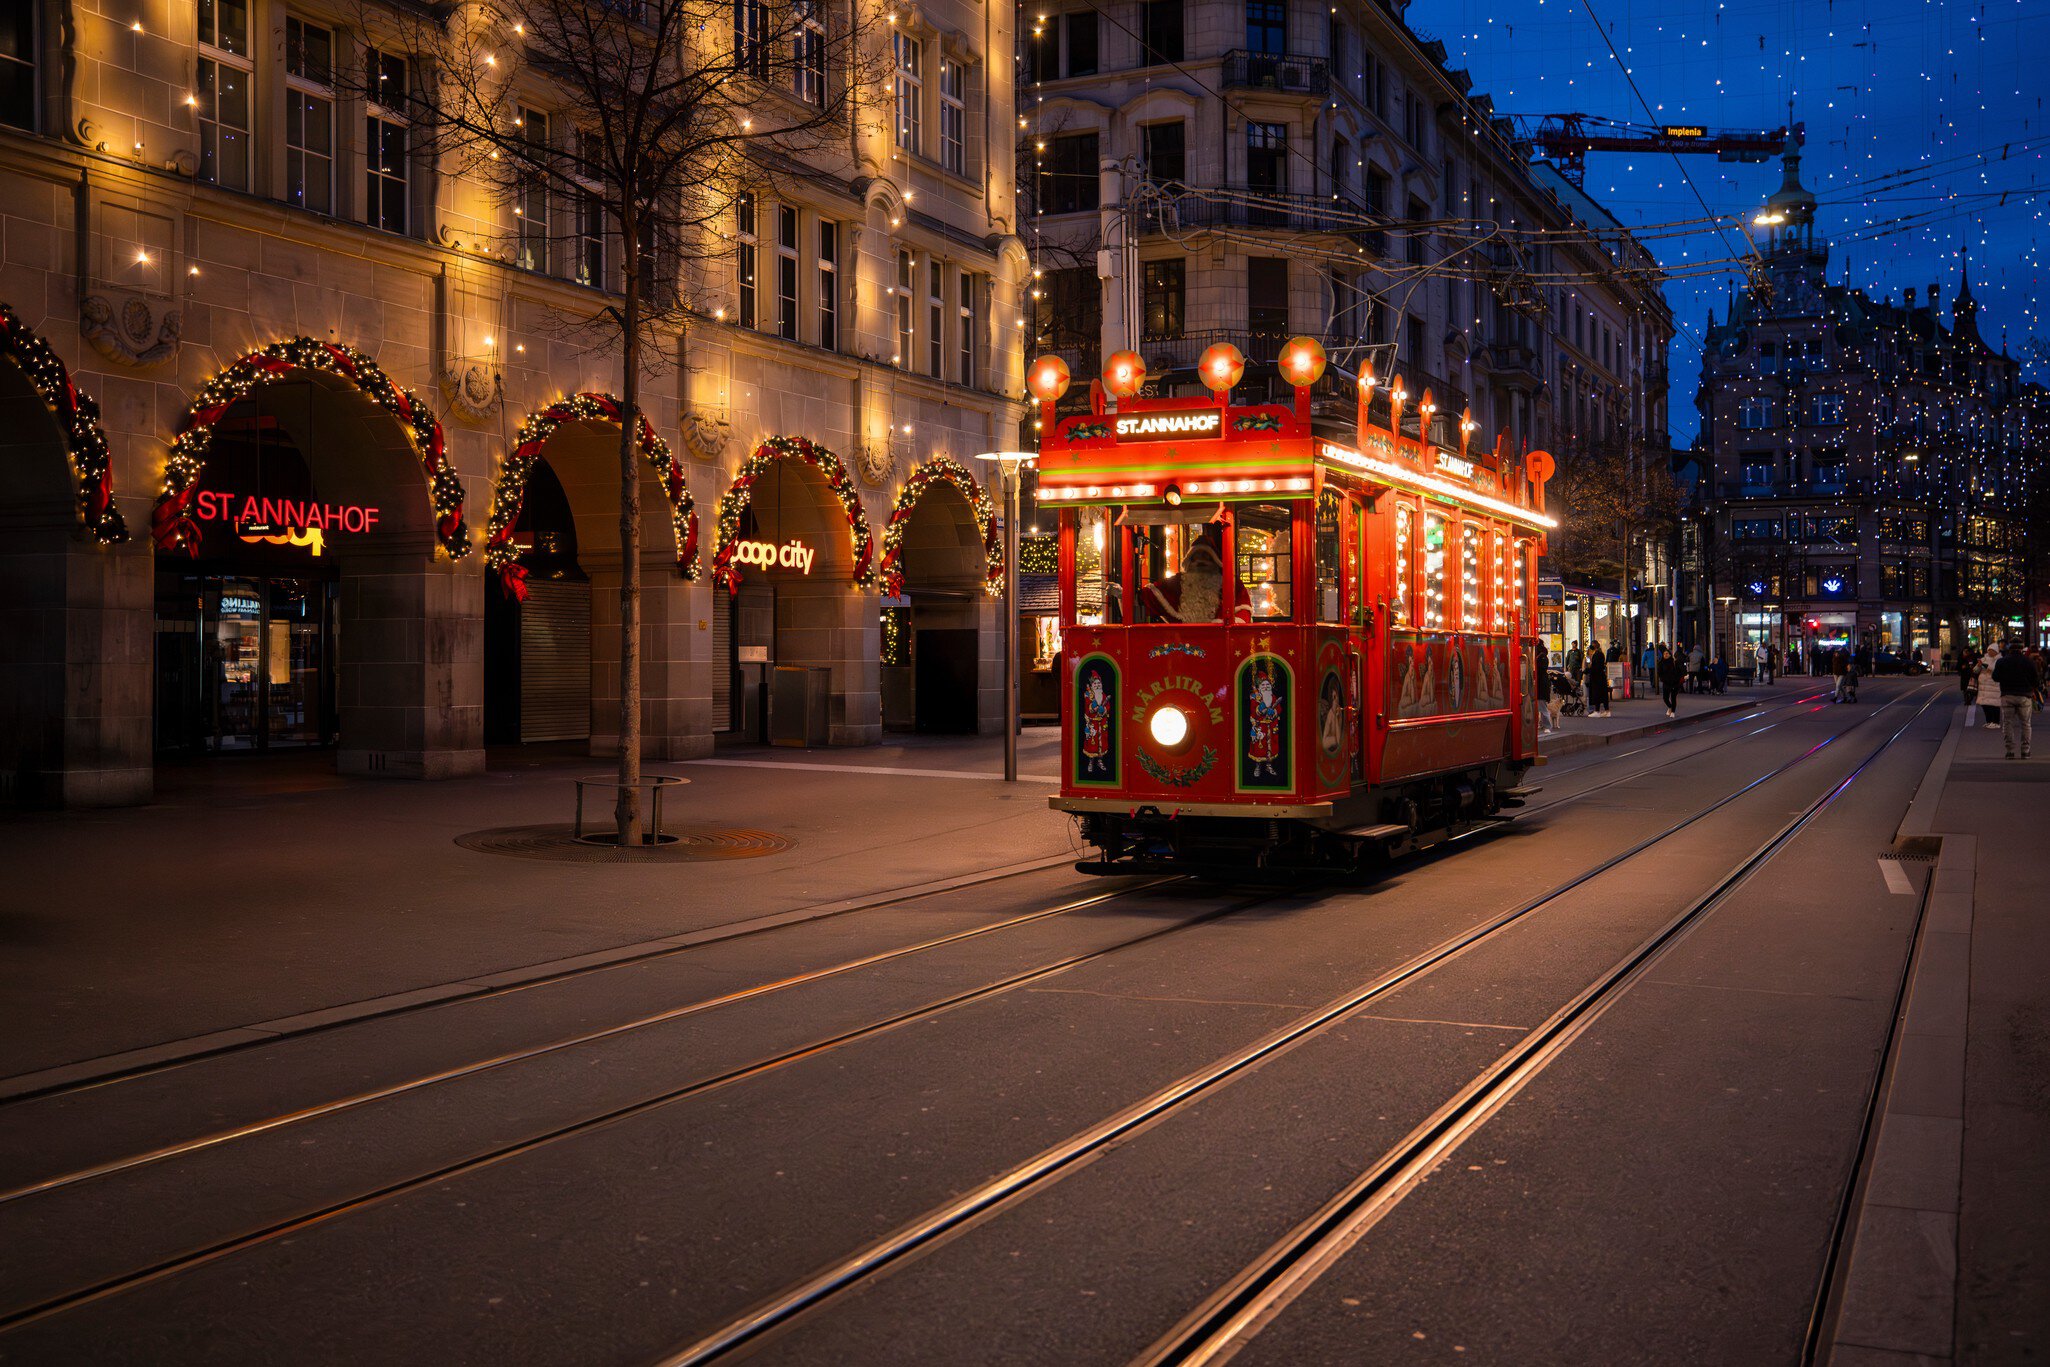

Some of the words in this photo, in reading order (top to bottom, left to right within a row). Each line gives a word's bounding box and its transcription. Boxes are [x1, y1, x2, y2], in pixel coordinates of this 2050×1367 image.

[1667, 127, 1702, 137] Implenia
[1116, 415, 1219, 434] ST.ANNAHOF
[197, 490, 379, 533] ST.ANNAHOF
[779, 540, 814, 575] city
[1132, 676, 1224, 725] MÄRLITRAM
